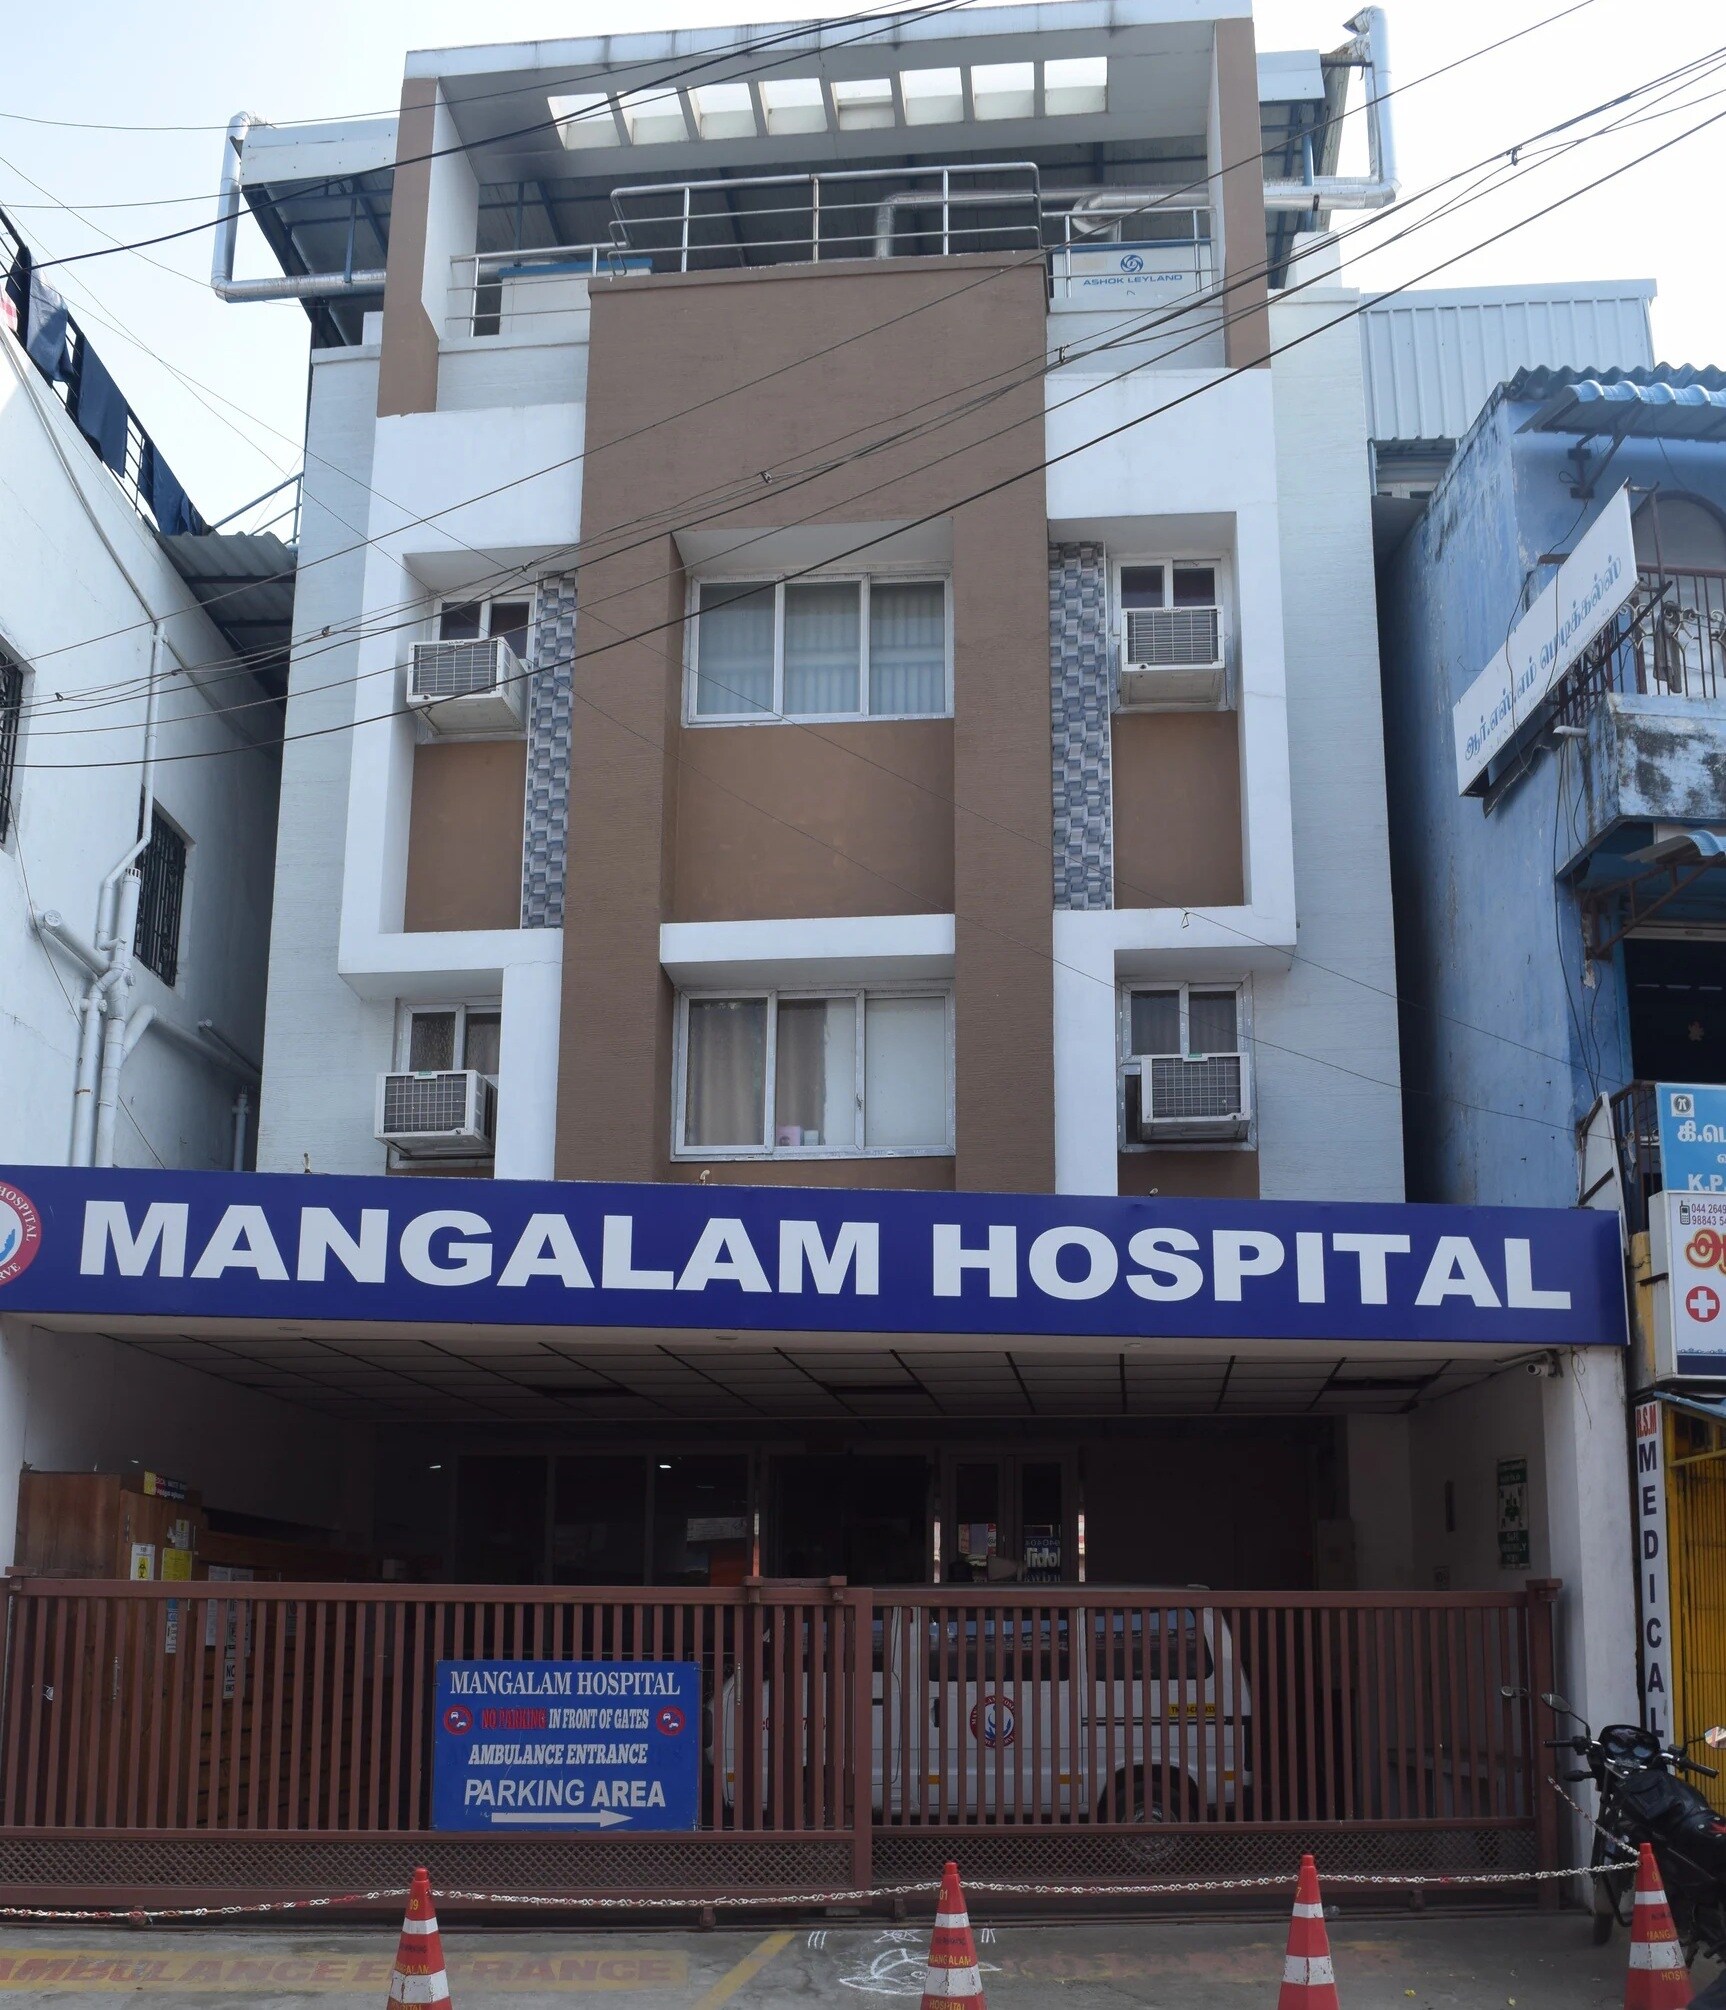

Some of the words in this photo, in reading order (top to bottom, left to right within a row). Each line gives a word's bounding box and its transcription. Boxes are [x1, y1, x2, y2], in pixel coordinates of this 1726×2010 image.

[1083, 278, 1124, 286] ASHOK
[1128, 274, 1183, 282] LEYLAND
[1691, 1203, 1706, 1213] 044
[1692, 1215, 1717, 1226] 98843
[79, 1200, 880, 1295] MANGALAM
[933, 1224, 1572, 1309] HOSPITAL
[1638, 1440, 1665, 1738] MEDICAL
[450, 1671, 571, 1695] MANGALAM
[577, 1672, 681, 1696] HOSPITAL
[481, 1708, 498, 1730] NO
[500, 1707, 546, 1730] PARKING
[548, 1708, 562, 1729] IN
[562, 1708, 598, 1729] FRONT
[599, 1708, 613, 1729] OF
[614, 1708, 649, 1729] GATES
[468, 1744, 564, 1765] AMBULANCE
[566, 1744, 648, 1764] ENTRANCE
[464, 1779, 585, 1807] PARKING
[591, 1780, 666, 1807] AREA
